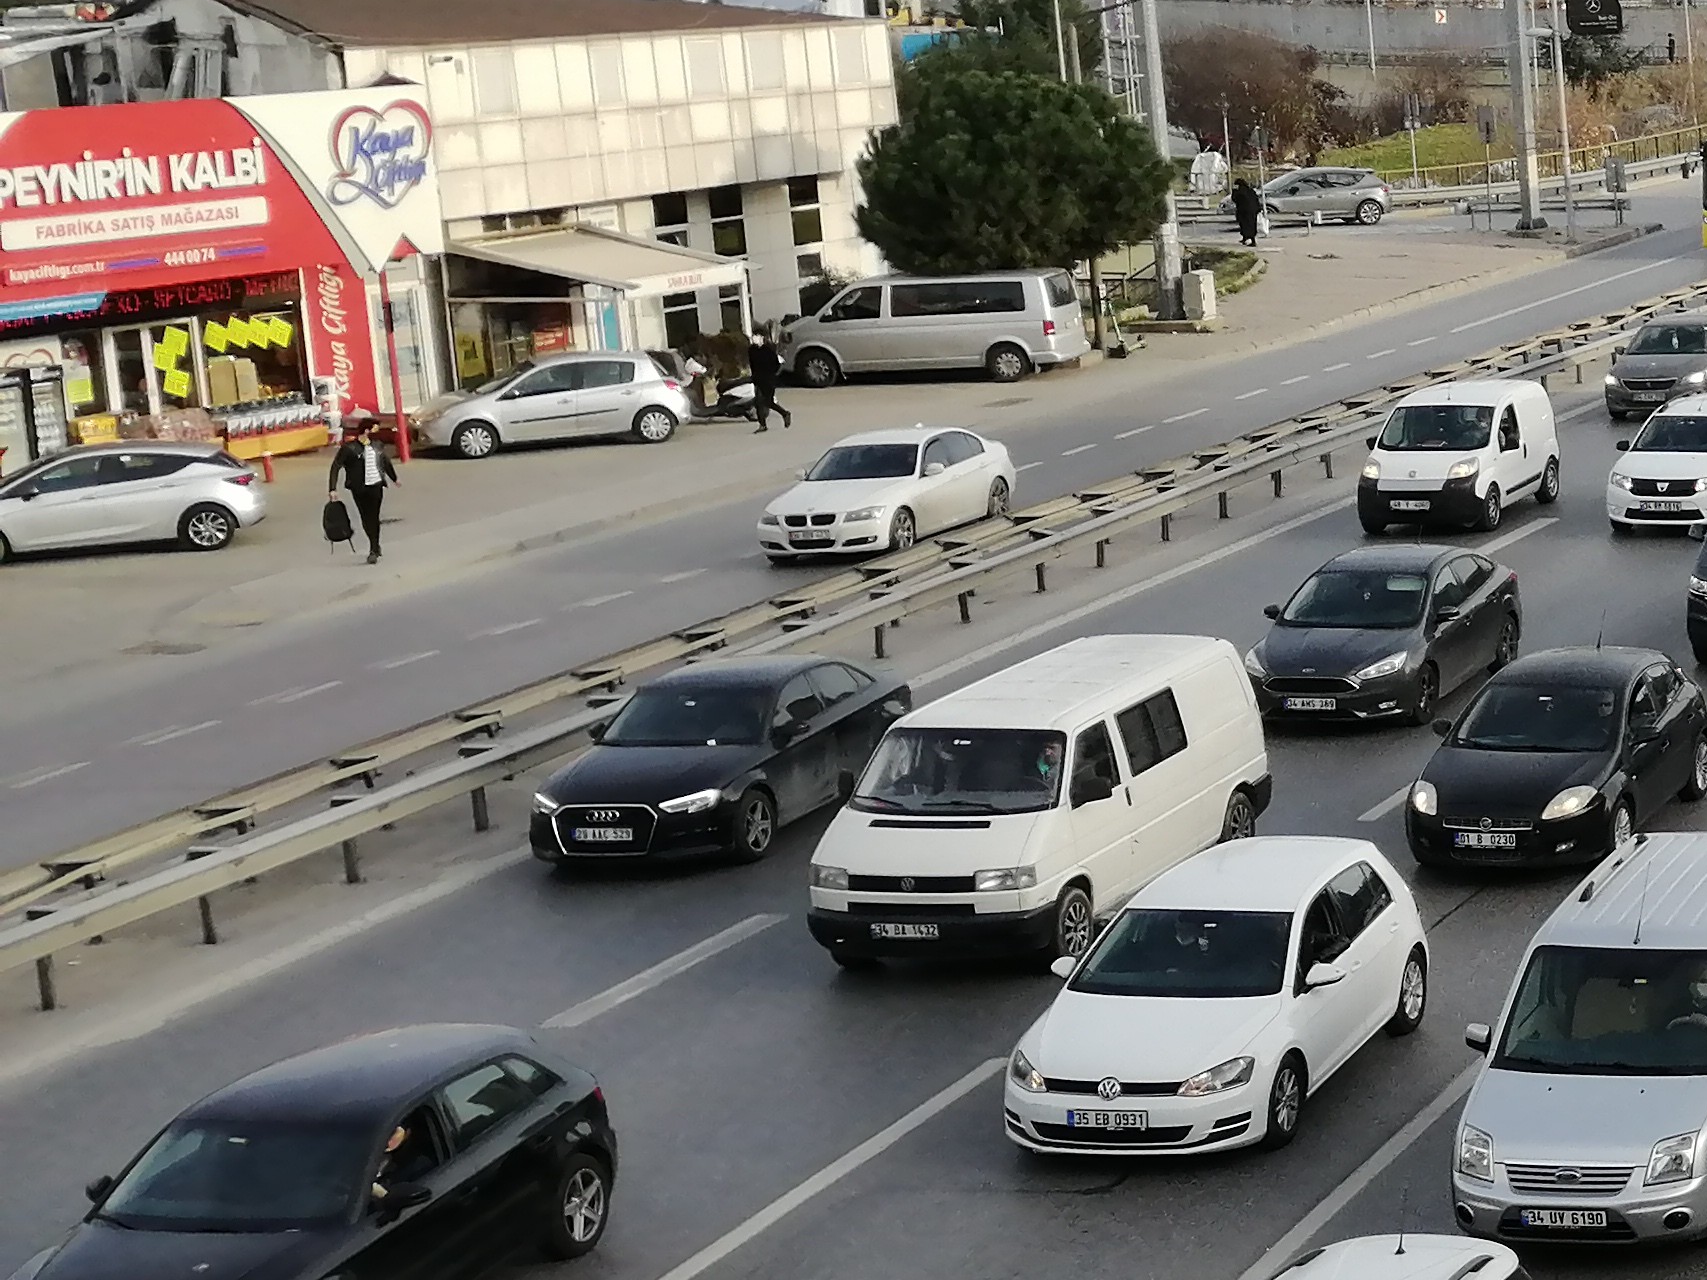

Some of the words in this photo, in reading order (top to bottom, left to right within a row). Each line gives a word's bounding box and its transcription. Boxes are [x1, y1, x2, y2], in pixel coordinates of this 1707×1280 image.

[168, 136, 266, 193] KALBİ
[35, 218, 105, 240] FABRİKA
[111, 214, 155, 232] SATIŞ
[161, 206, 240, 227] MAĞAZASI
[164, 253, 184, 267] 444
[201, 248, 215, 263] 74
[876, 924, 889, 936] 34
[1075, 1112, 1089, 1125] 35
[1094, 1113, 1110, 1126] EB
[1114, 1113, 1144, 1126] 0931
[1529, 1211, 1546, 1224] 34
[1549, 1212, 1565, 1225] UV
[1571, 1212, 1604, 1226] 6190
